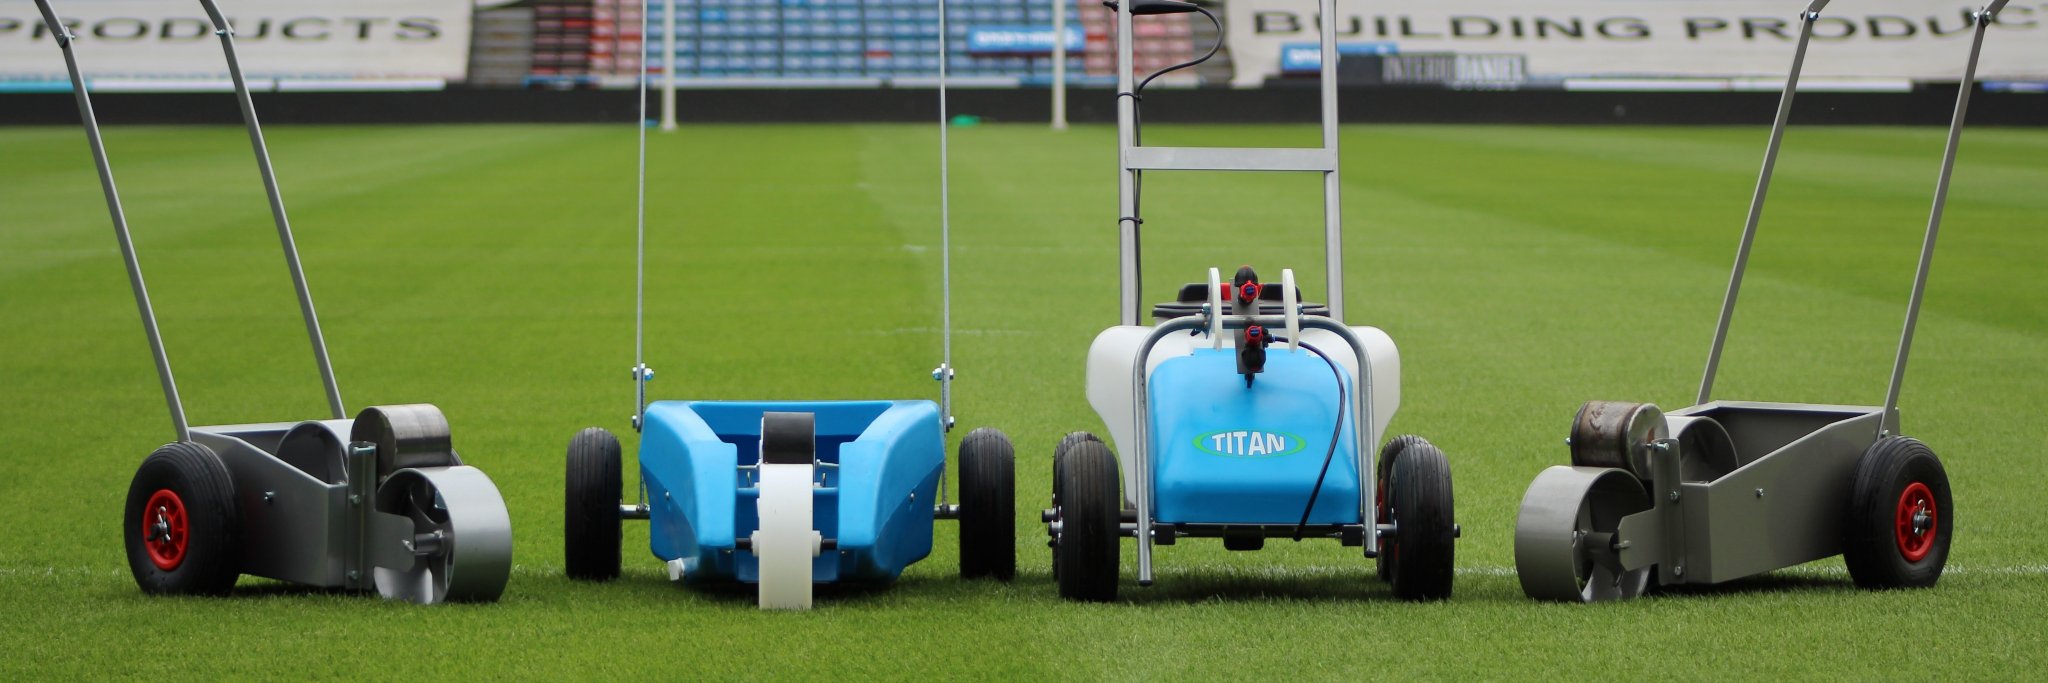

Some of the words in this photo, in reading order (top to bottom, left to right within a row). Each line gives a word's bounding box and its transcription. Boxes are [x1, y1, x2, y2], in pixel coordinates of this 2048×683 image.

[1254, 11, 1652, 41] BUILDING
[1684, 4, 2048, 41] PRODUC
[1211, 430, 1285, 455] TITAN
